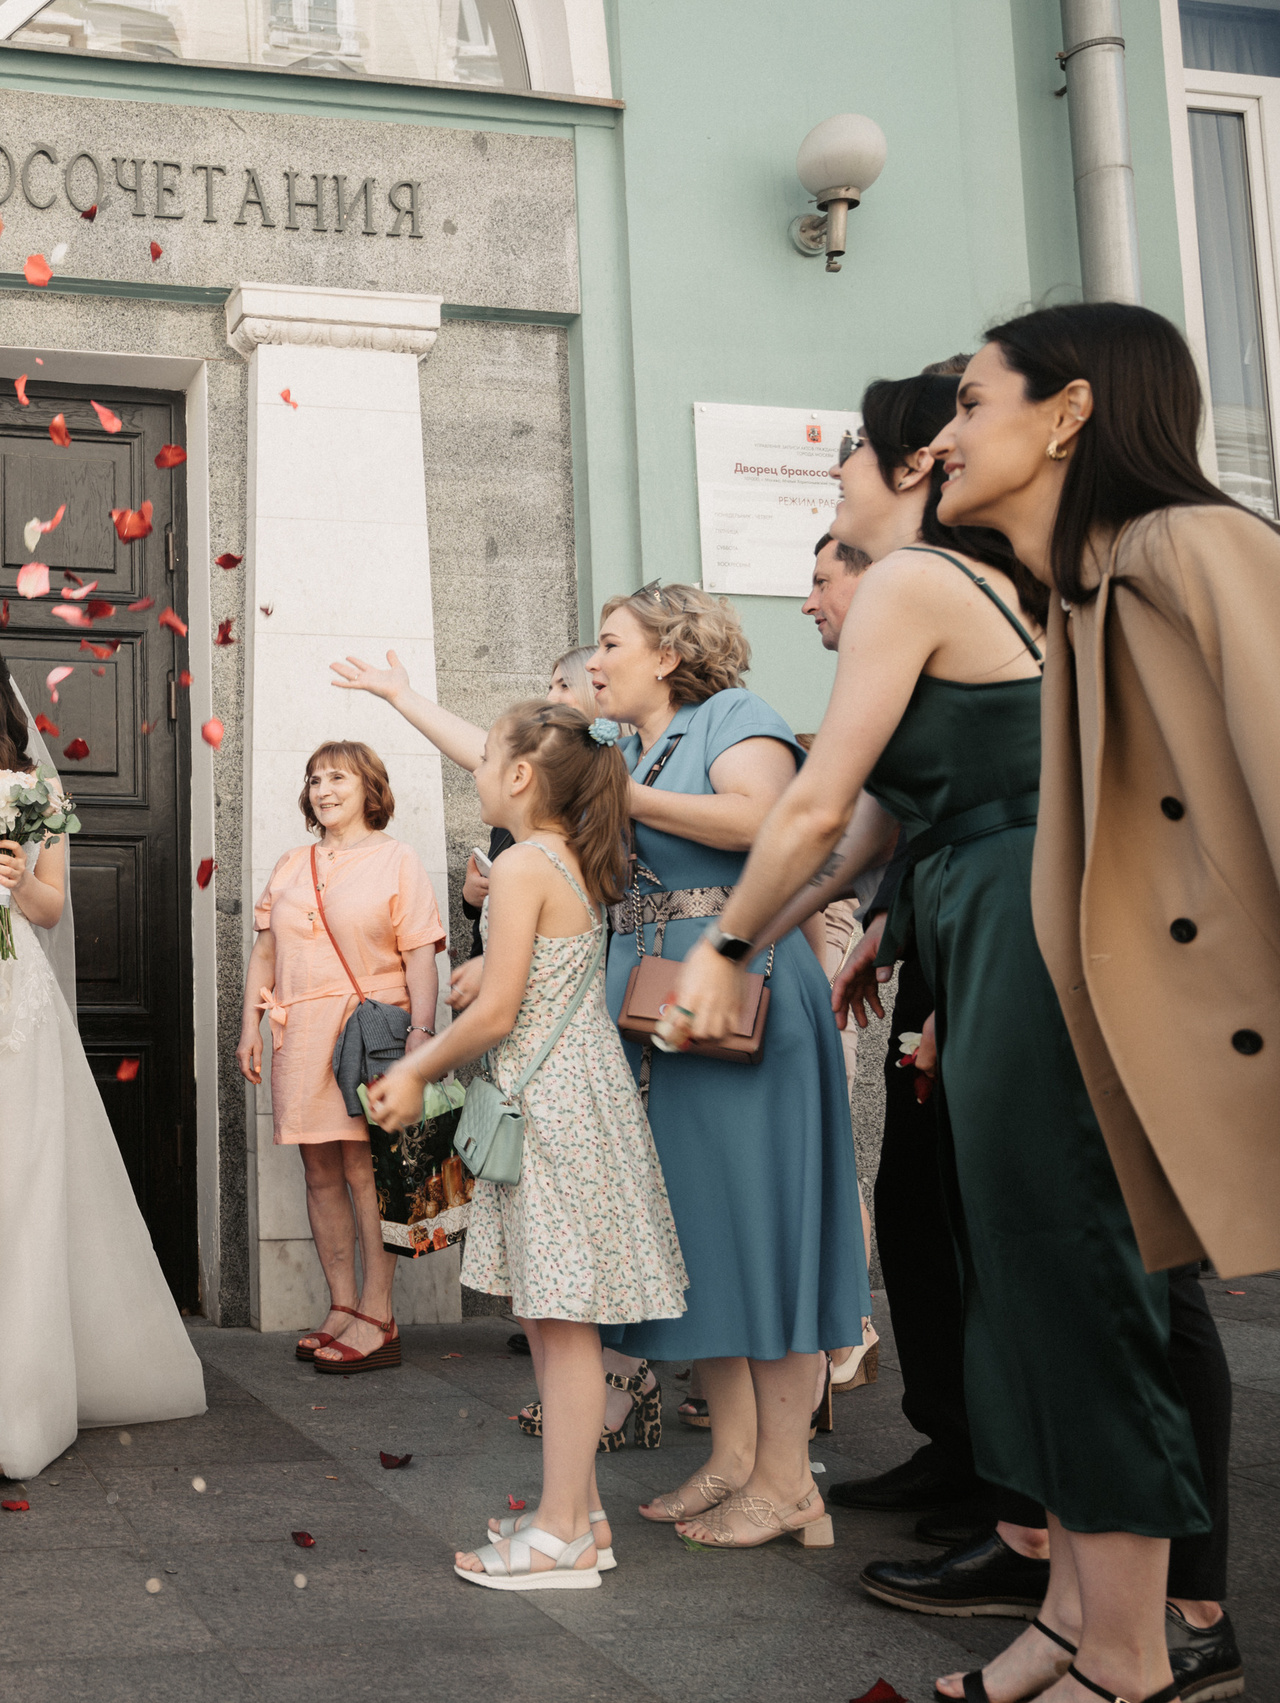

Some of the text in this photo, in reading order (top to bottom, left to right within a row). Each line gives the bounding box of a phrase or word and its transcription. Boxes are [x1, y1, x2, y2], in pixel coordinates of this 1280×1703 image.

[734, 462, 829, 478] Дворец бракосо
[778, 496, 843, 508] РЕЖИМ РАБ
